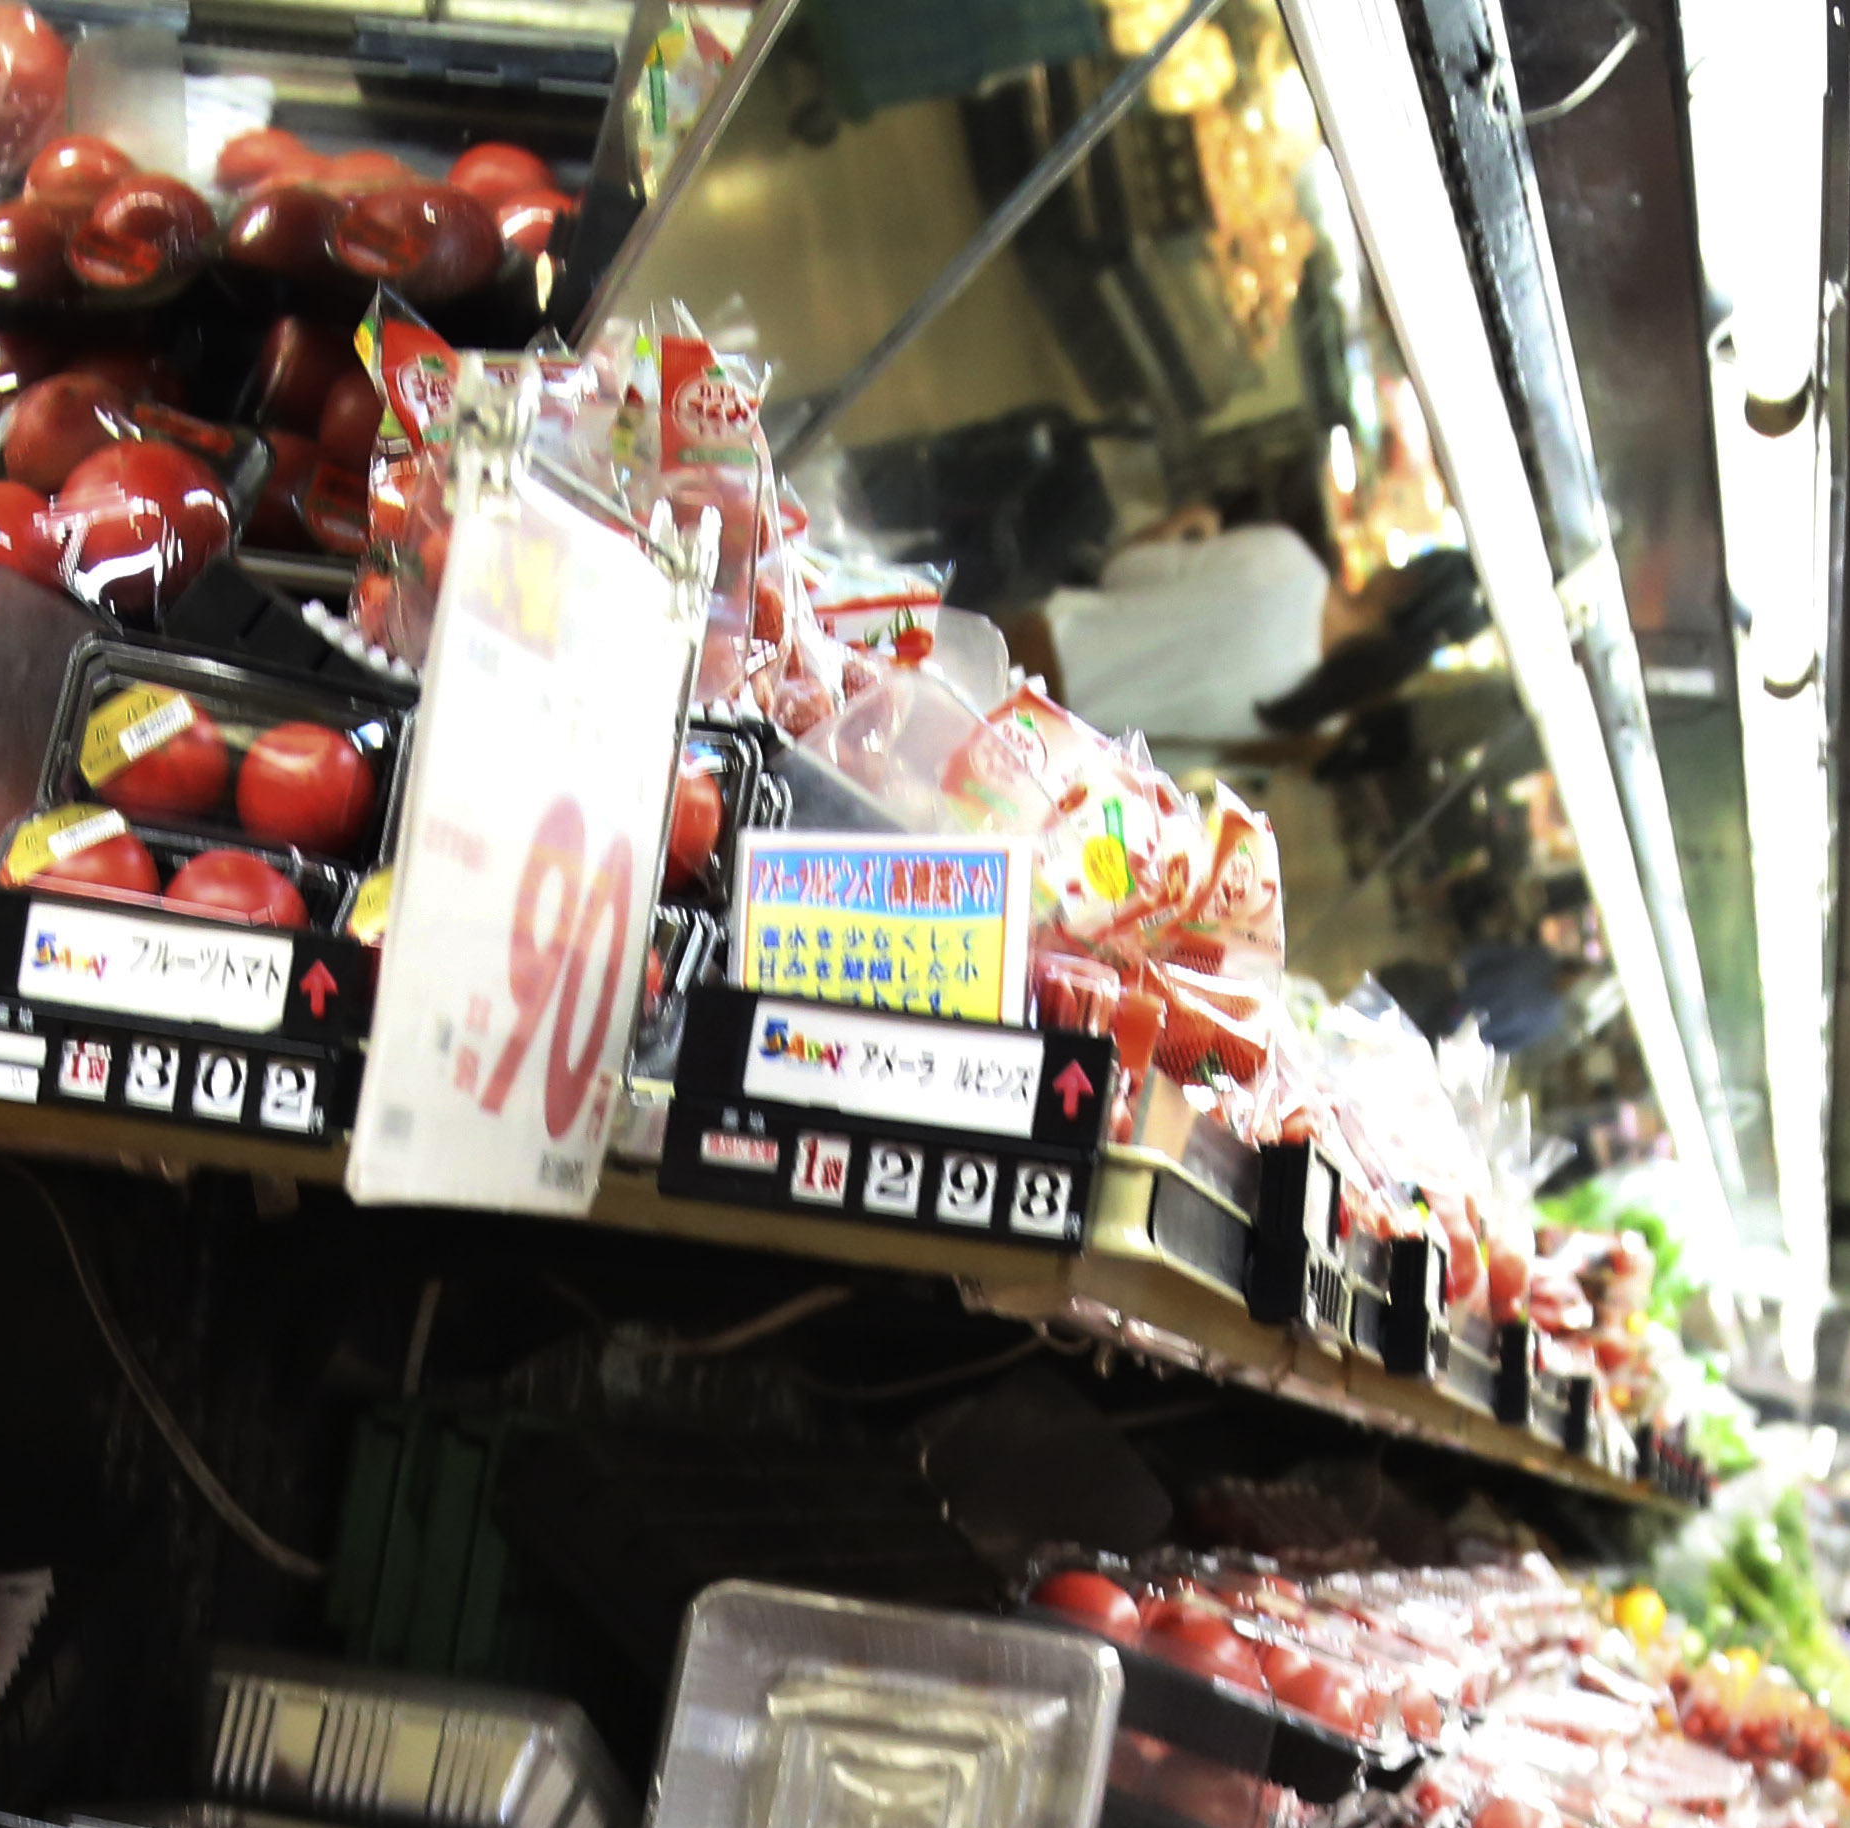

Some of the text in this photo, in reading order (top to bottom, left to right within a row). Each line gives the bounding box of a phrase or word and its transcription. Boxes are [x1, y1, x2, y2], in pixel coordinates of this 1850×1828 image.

[128, 934, 282, 1000] フルーツトマト
[134, 1041, 309, 1113] 302
[859, 1038, 937, 1088] アメーラ
[952, 1053, 1037, 1105] ルビンズ
[877, 1147, 1062, 1221] 298
